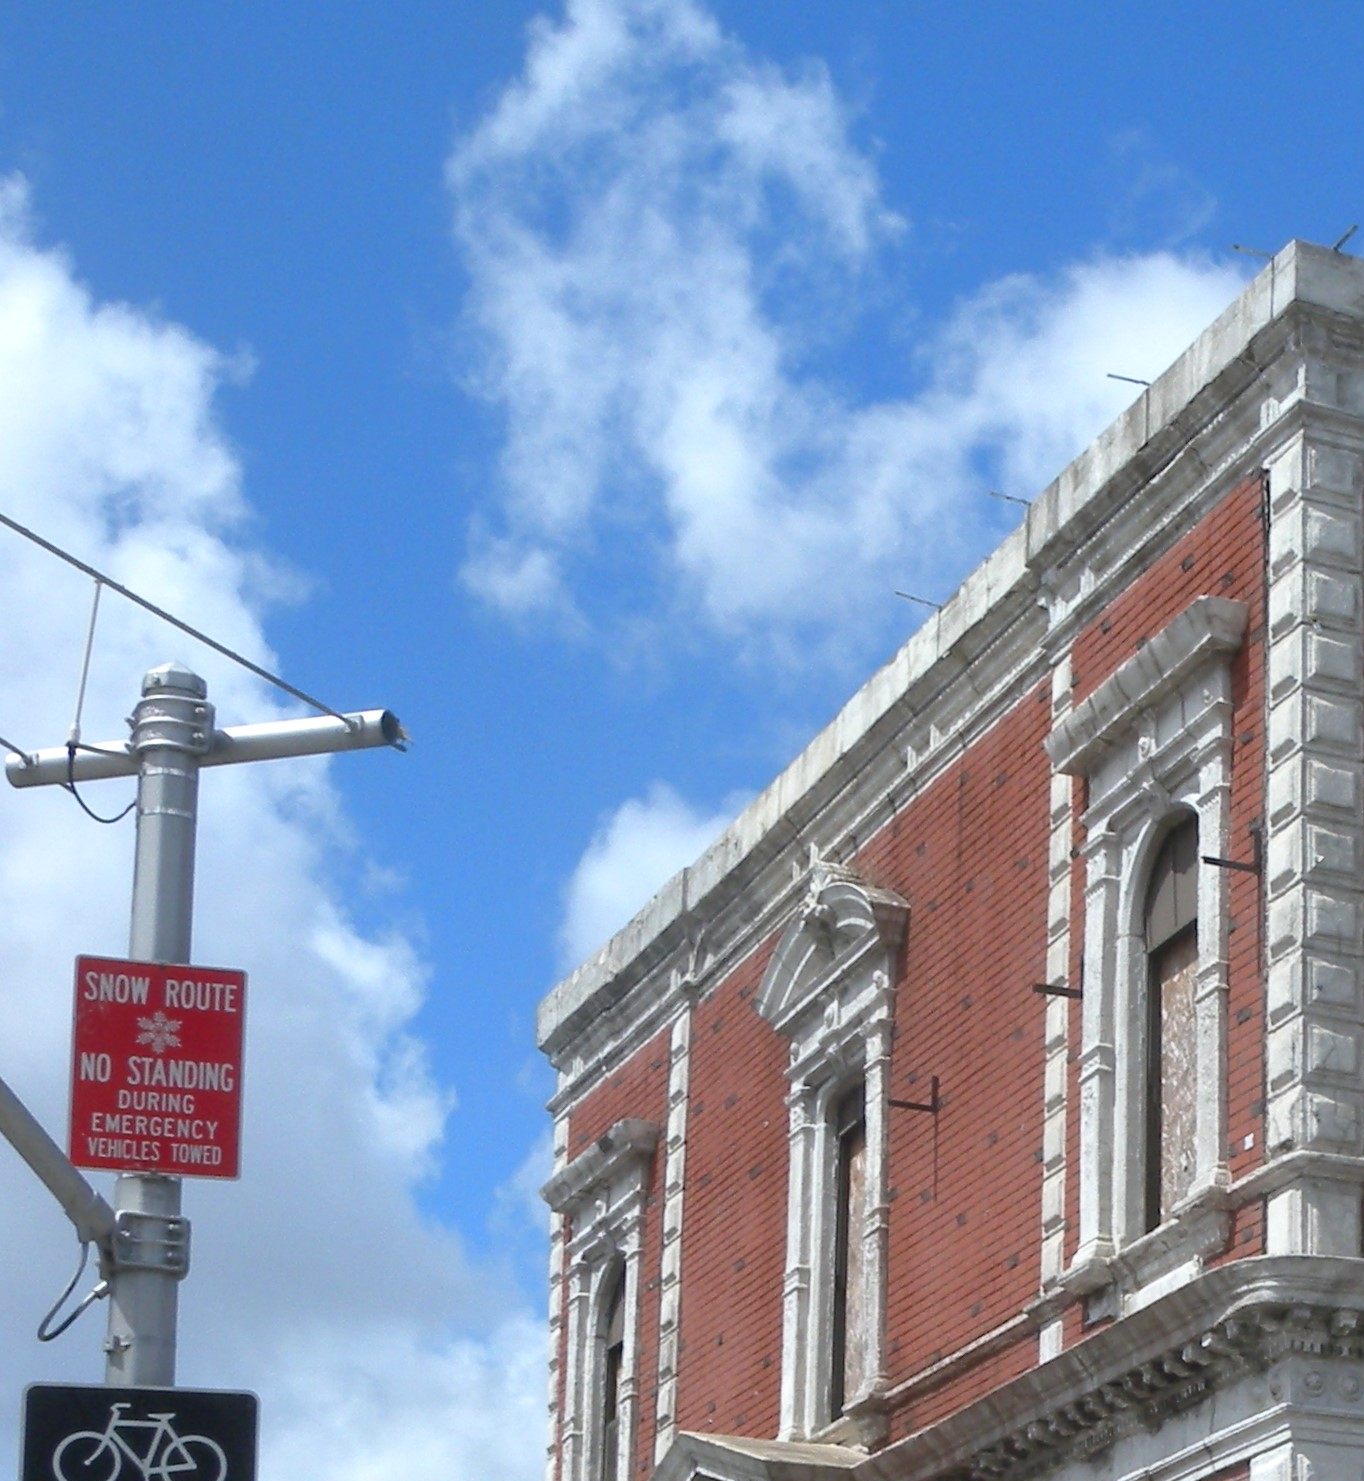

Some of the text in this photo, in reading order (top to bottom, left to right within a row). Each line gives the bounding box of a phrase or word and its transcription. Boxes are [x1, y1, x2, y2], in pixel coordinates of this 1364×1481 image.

[84, 971, 237, 1013] SNOW ROUTE
[80, 1052, 234, 1092] NO STANDING
[118, 1090, 195, 1114] DURING
[91, 1114, 219, 1139] EMERGENCY
[87, 1137, 222, 1165] VEHICLES TOWED
